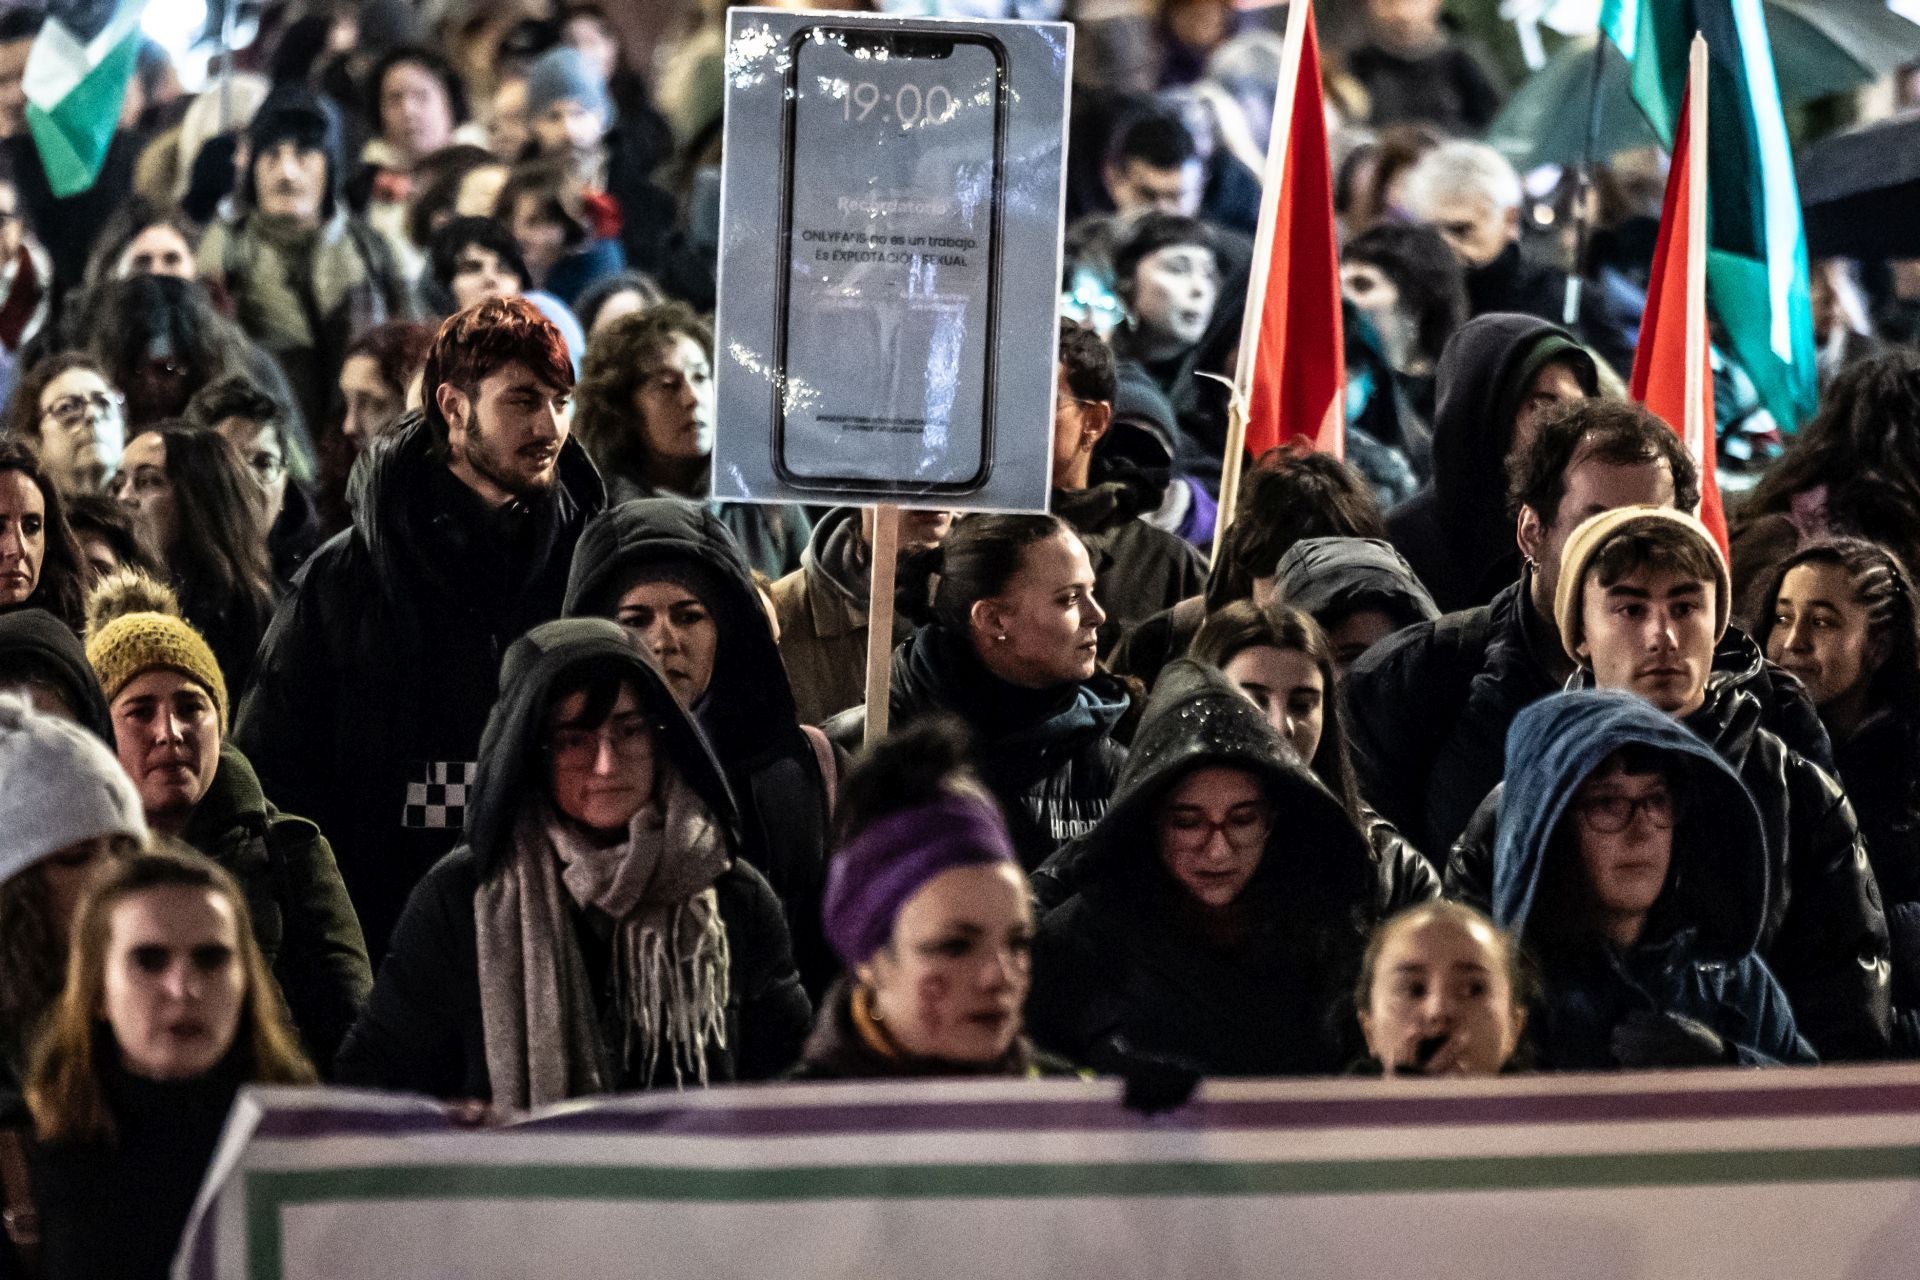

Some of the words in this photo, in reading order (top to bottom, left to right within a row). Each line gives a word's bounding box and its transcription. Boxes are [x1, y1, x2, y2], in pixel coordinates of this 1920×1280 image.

[890, 236, 905, 246] es
[908, 237, 925, 246] un
[922, 254, 967, 267] SEXUAL
